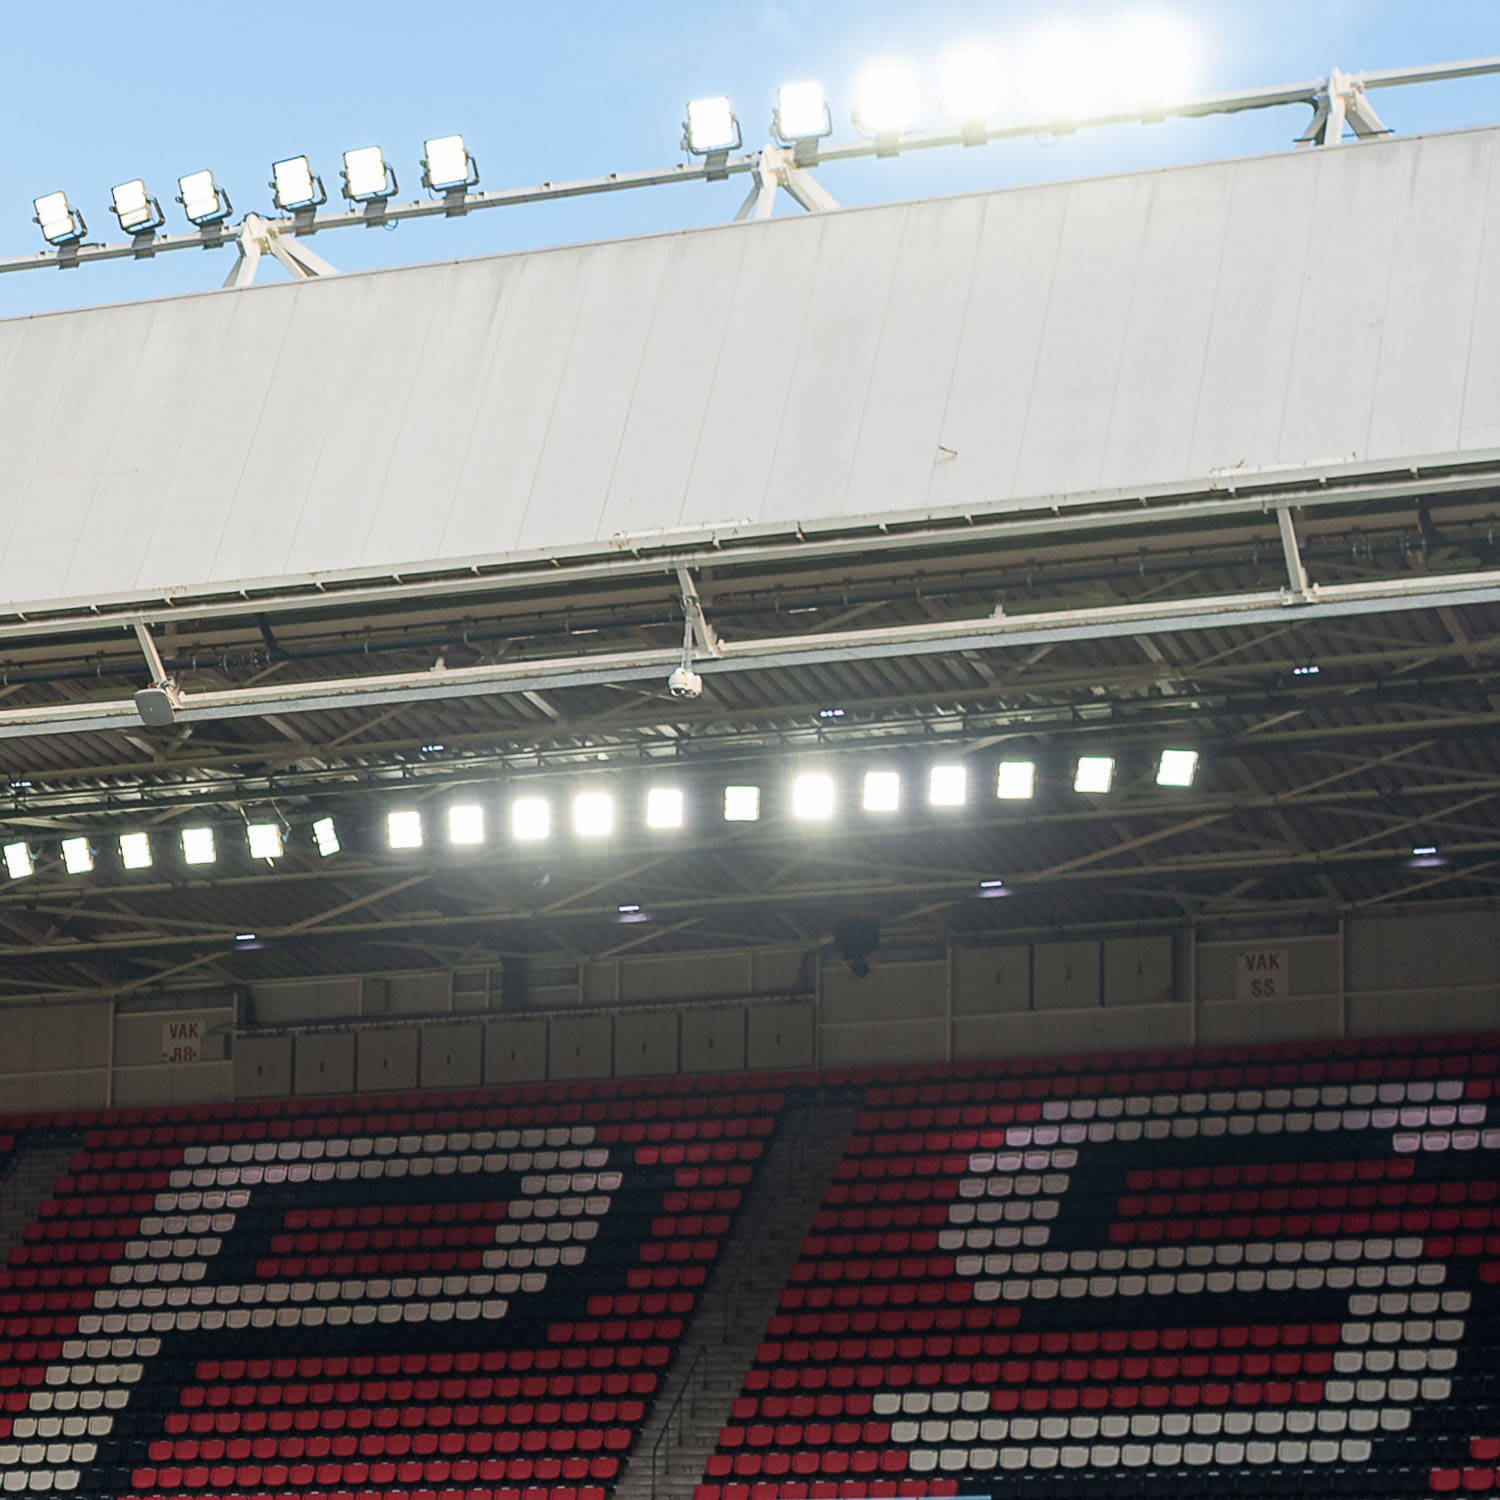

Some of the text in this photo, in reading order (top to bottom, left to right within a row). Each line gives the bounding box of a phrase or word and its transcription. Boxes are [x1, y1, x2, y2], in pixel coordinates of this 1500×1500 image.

[1246, 953, 1280, 971] VAK
[1251, 979, 1275, 997] SS
[170, 1023, 199, 1039] VAK
